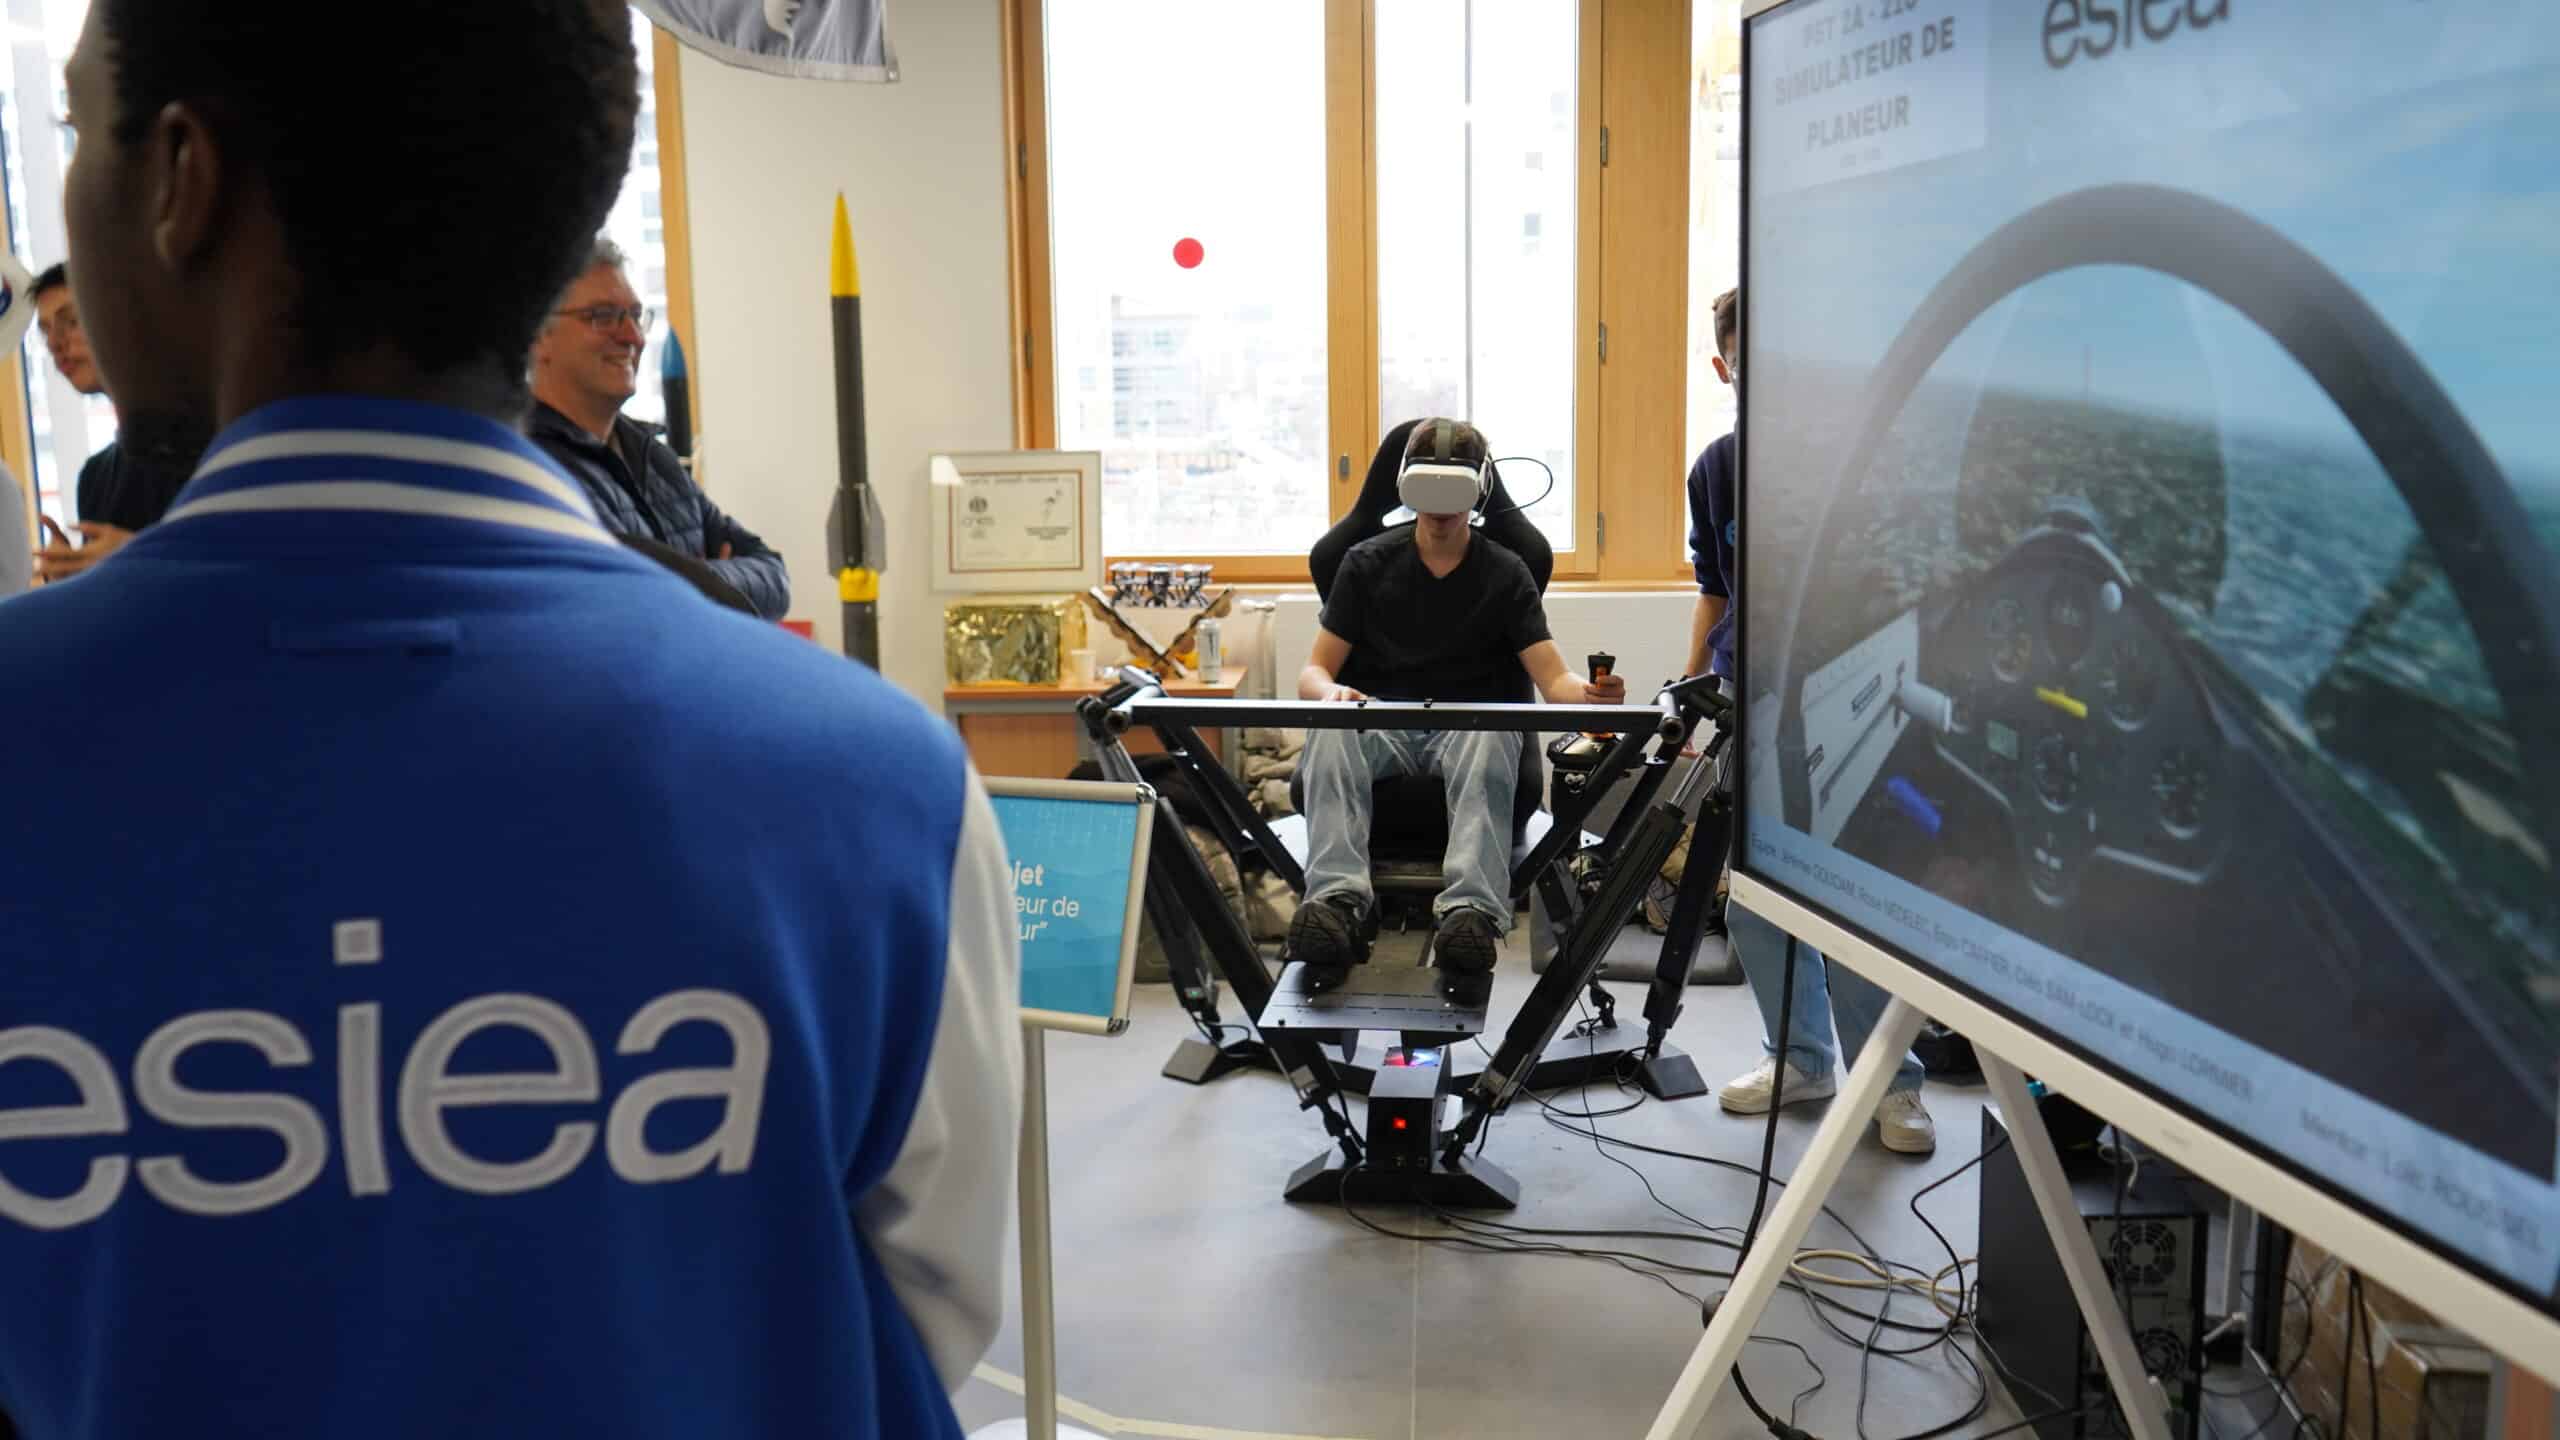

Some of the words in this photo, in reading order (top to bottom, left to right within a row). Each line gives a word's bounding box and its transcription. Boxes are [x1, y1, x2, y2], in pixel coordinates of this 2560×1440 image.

[1775, 31, 1912, 106] SIMULATEUR
[1921, 15, 1955, 57] DE
[1806, 95, 1910, 149] PLANEUR
[1052, 895, 1079, 918] de
[0, 919, 770, 1229] esiea
